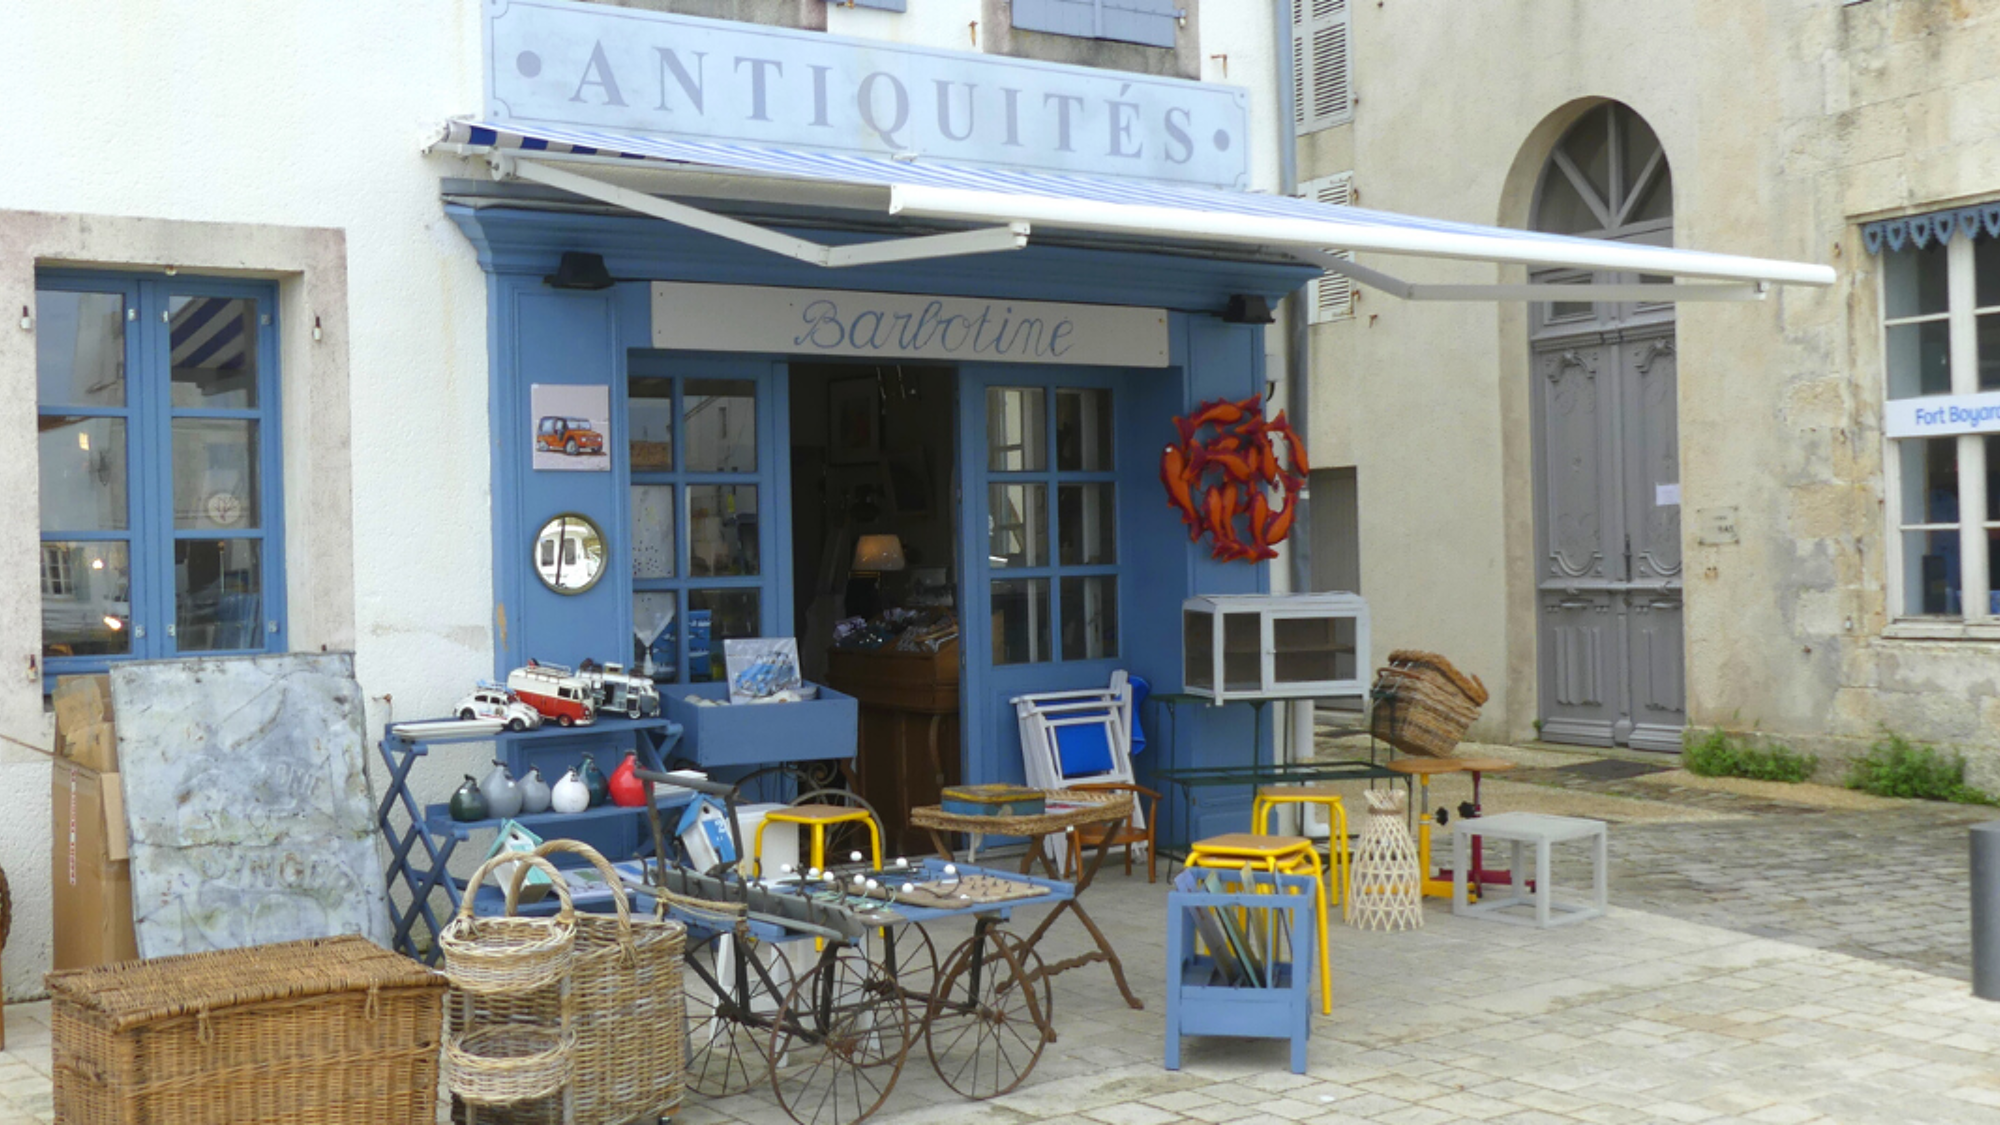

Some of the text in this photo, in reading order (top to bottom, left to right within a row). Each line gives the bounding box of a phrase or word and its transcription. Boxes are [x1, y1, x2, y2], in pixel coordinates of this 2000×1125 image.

[567, 39, 1195, 164] ANTIQUITÉS
[793, 300, 1074, 357] Barbotine
[1915, 406, 1946, 425] Fort
